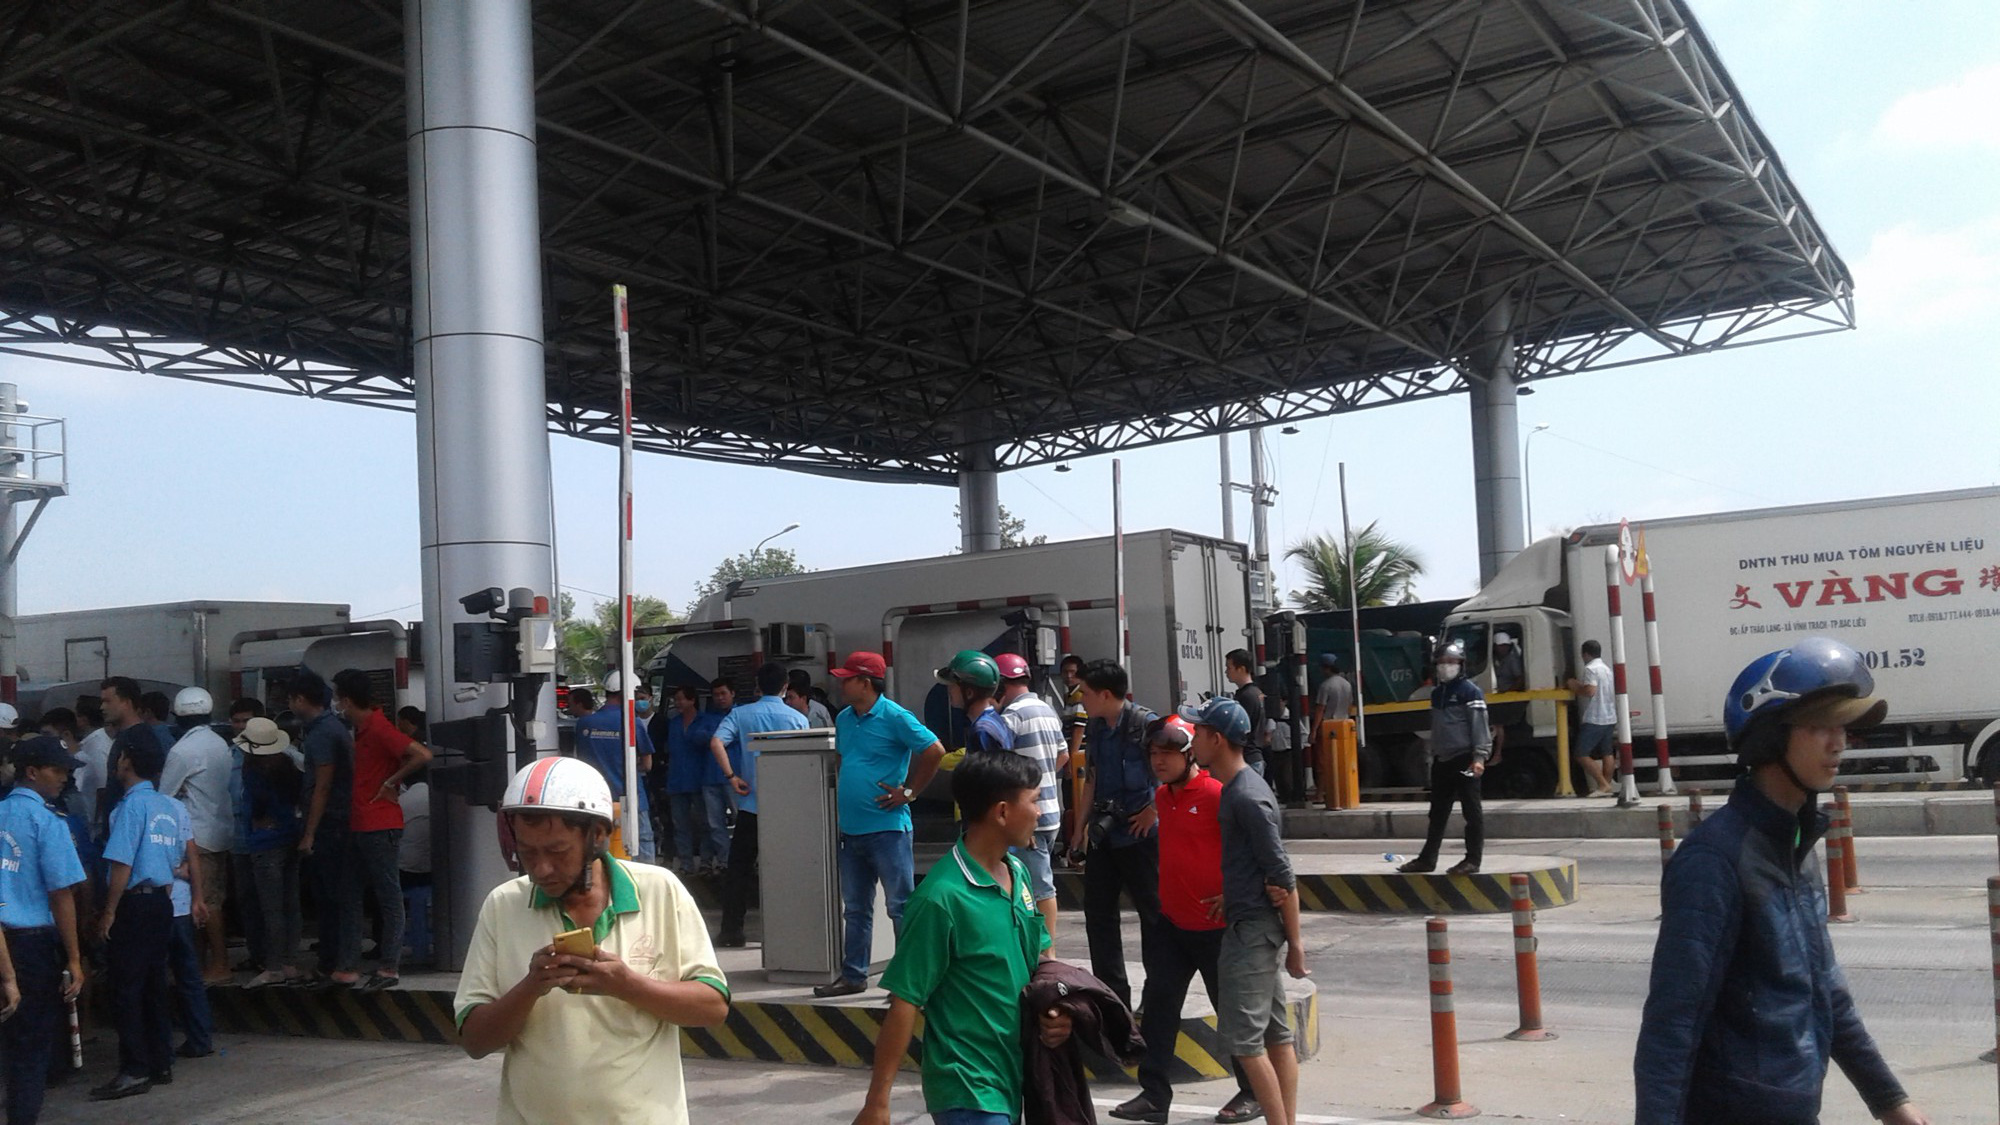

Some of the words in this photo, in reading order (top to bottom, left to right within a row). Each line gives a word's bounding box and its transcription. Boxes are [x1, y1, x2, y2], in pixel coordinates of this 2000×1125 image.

[1739, 557, 1777, 570] DNTN
[1781, 553, 1809, 565] THU
[1814, 550, 1844, 563] MUA
[1849, 546, 1880, 560] TÔM
[1885, 541, 1946, 557] NGUYÊN
[1951, 537, 1984, 554] LIỆU
[1773, 568, 1964, 608] VÀNG
[1185, 629, 1198, 645] 71C
